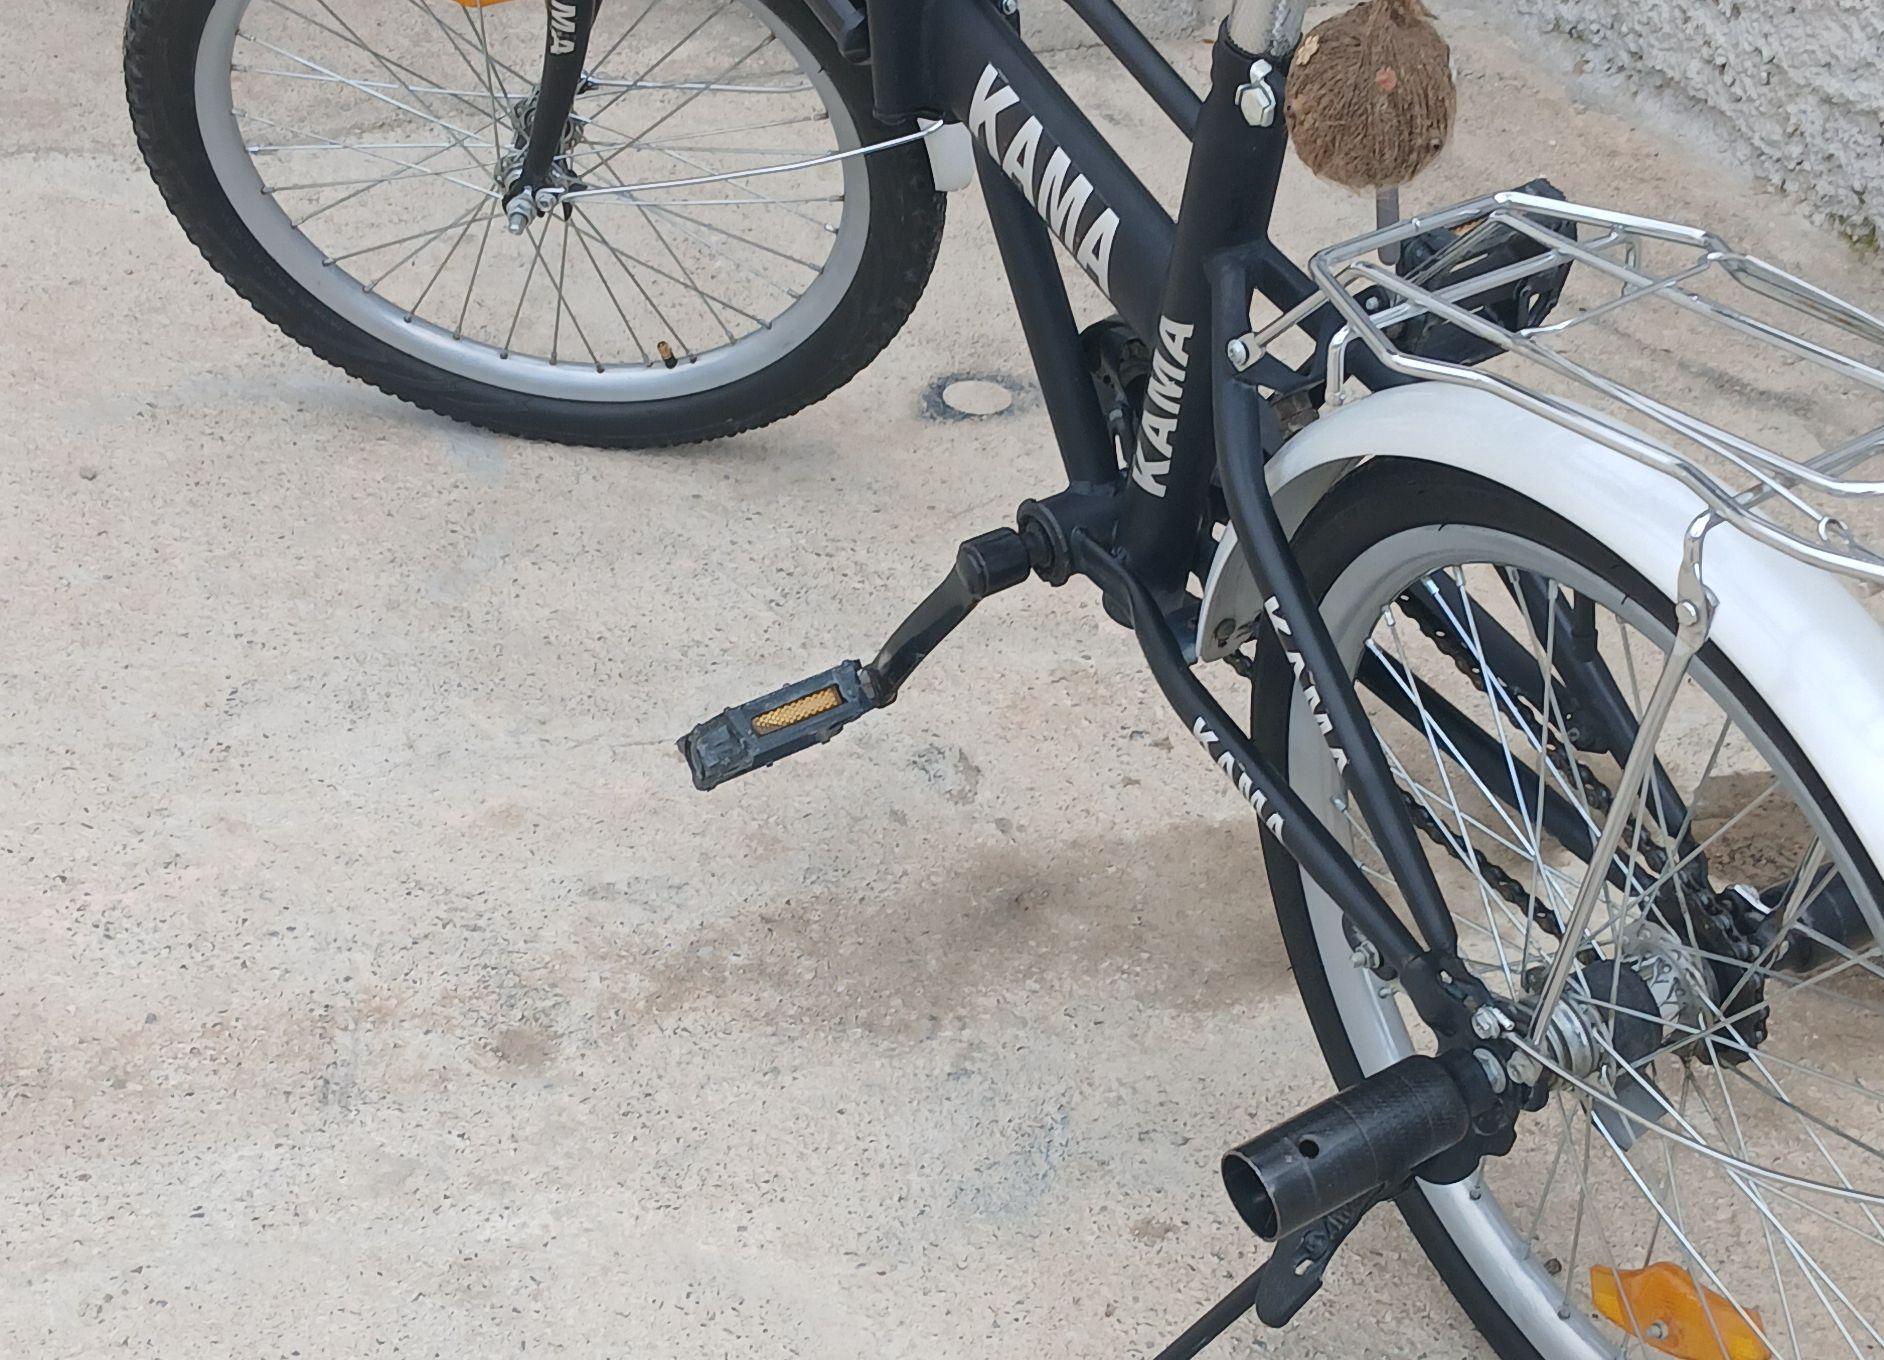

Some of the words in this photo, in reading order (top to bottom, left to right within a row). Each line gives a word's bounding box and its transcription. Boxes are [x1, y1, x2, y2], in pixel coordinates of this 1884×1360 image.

[969, 62, 1120, 299] KAMA
[1132, 315, 1194, 498] KAMA
[1264, 595, 1348, 775] KAMA
[1193, 717, 1285, 843] KAMA
